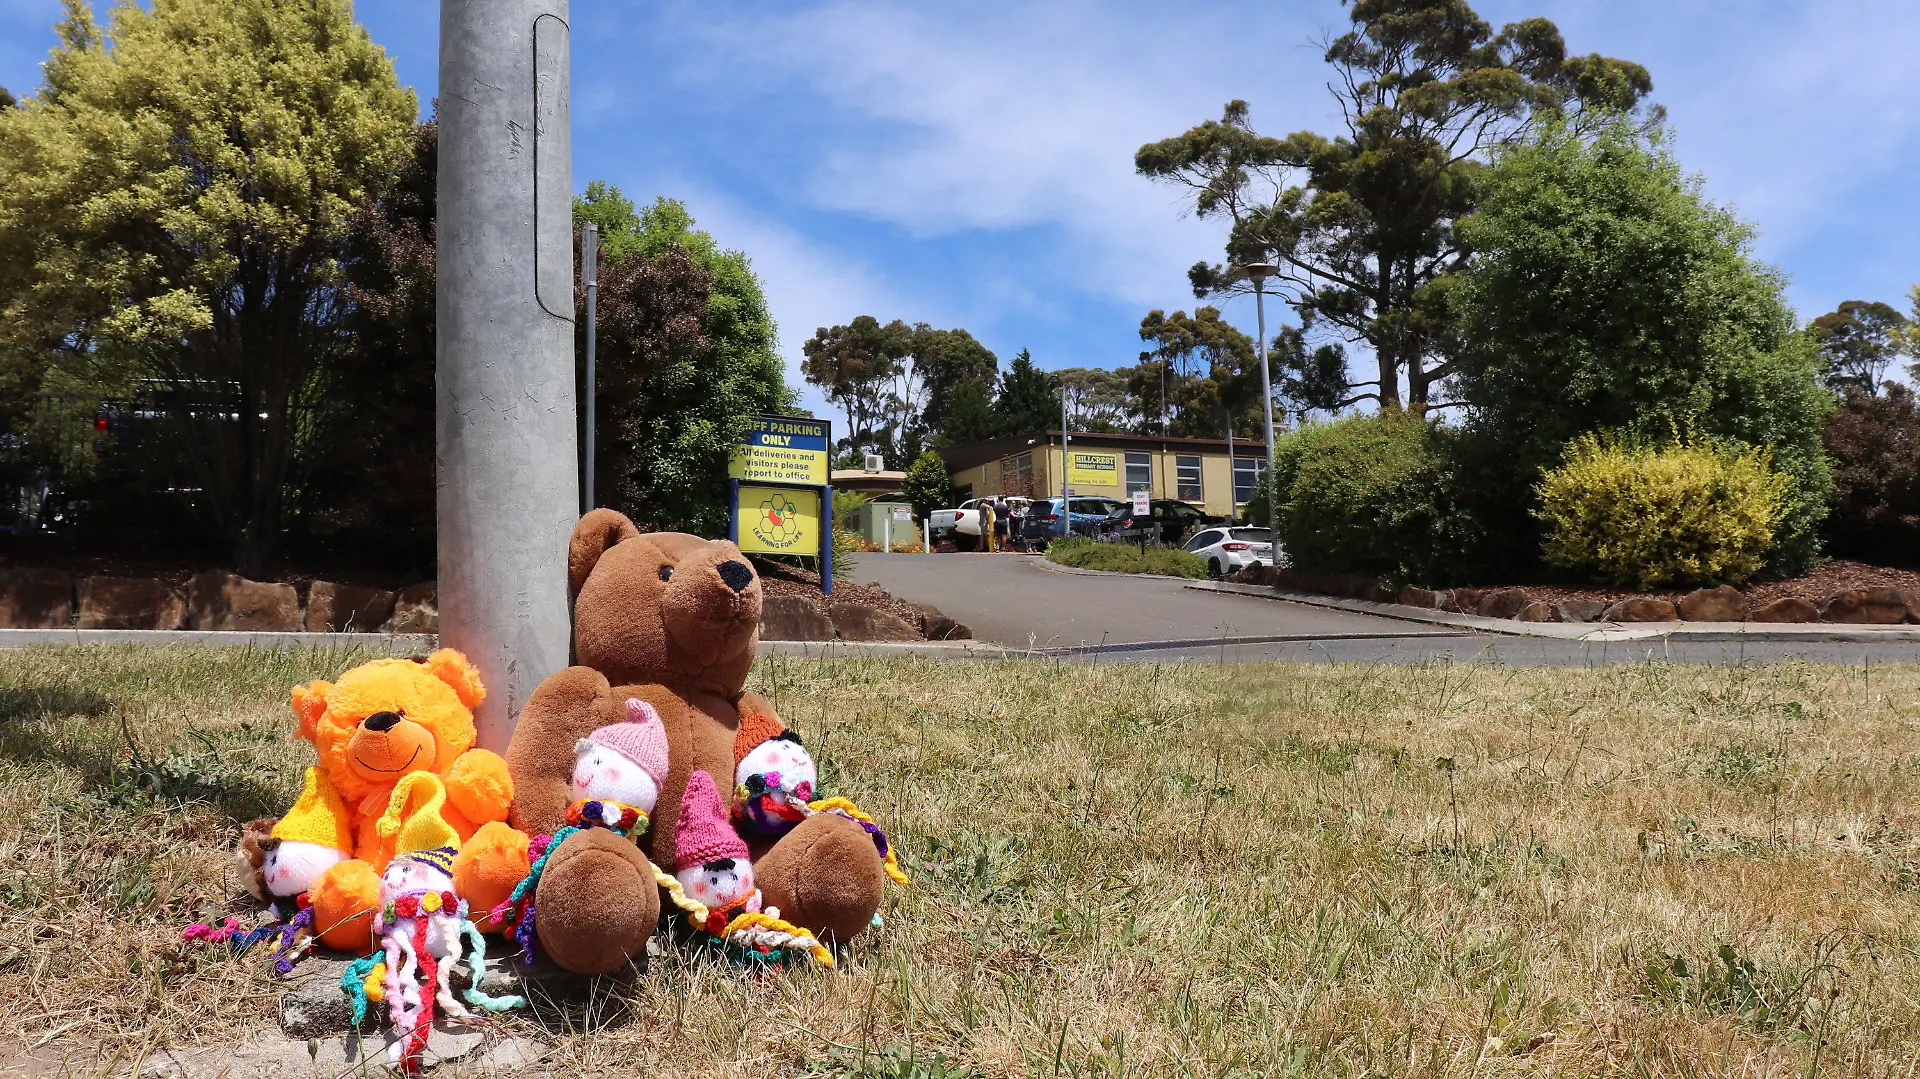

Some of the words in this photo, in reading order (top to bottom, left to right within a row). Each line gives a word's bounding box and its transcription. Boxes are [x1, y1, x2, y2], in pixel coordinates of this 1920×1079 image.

[770, 422, 822, 436] PARKING
[761, 434, 792, 446] ONLY
[754, 449, 797, 460] deliveries
[799, 453, 815, 461] and
[1076, 456, 1114, 464] HILLCREST
[745, 460, 779, 468] visitors
[781, 461, 809, 471] please
[744, 469, 772, 478] report
[774, 470, 783, 478] to
[785, 472, 811, 480] office
[752, 527, 780, 549] LEARNING
[780, 540, 793, 548] FOR
[792, 530, 803, 543] LIFE
